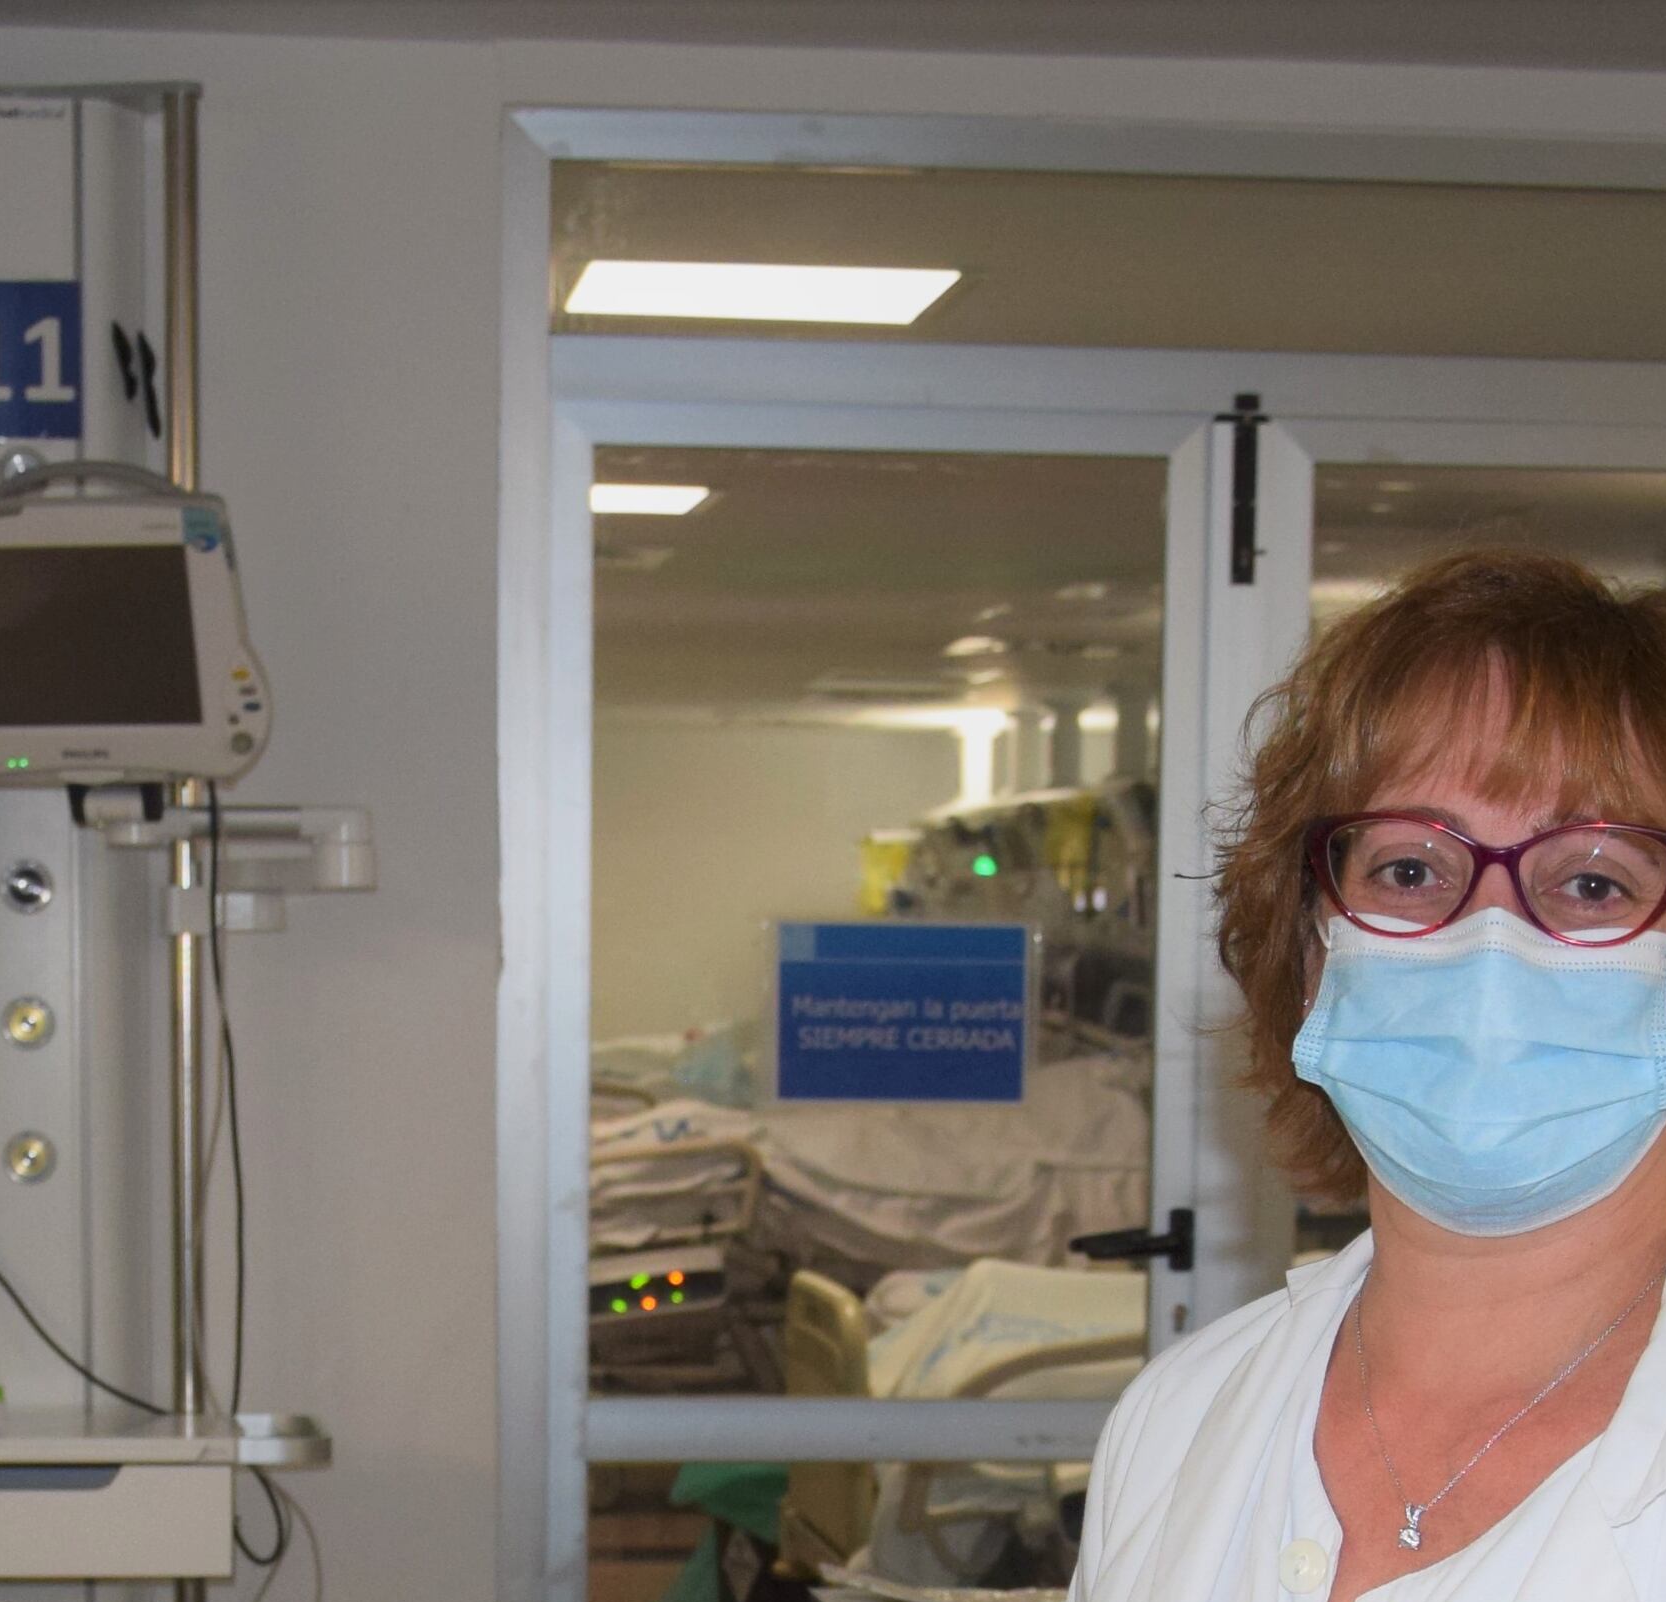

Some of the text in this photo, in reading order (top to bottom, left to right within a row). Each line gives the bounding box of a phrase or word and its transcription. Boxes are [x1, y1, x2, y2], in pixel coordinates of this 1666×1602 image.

[792, 994, 1023, 1024] Mantengan la puerta
[798, 1026, 1016, 1051] SIEMPRE CERRADA
